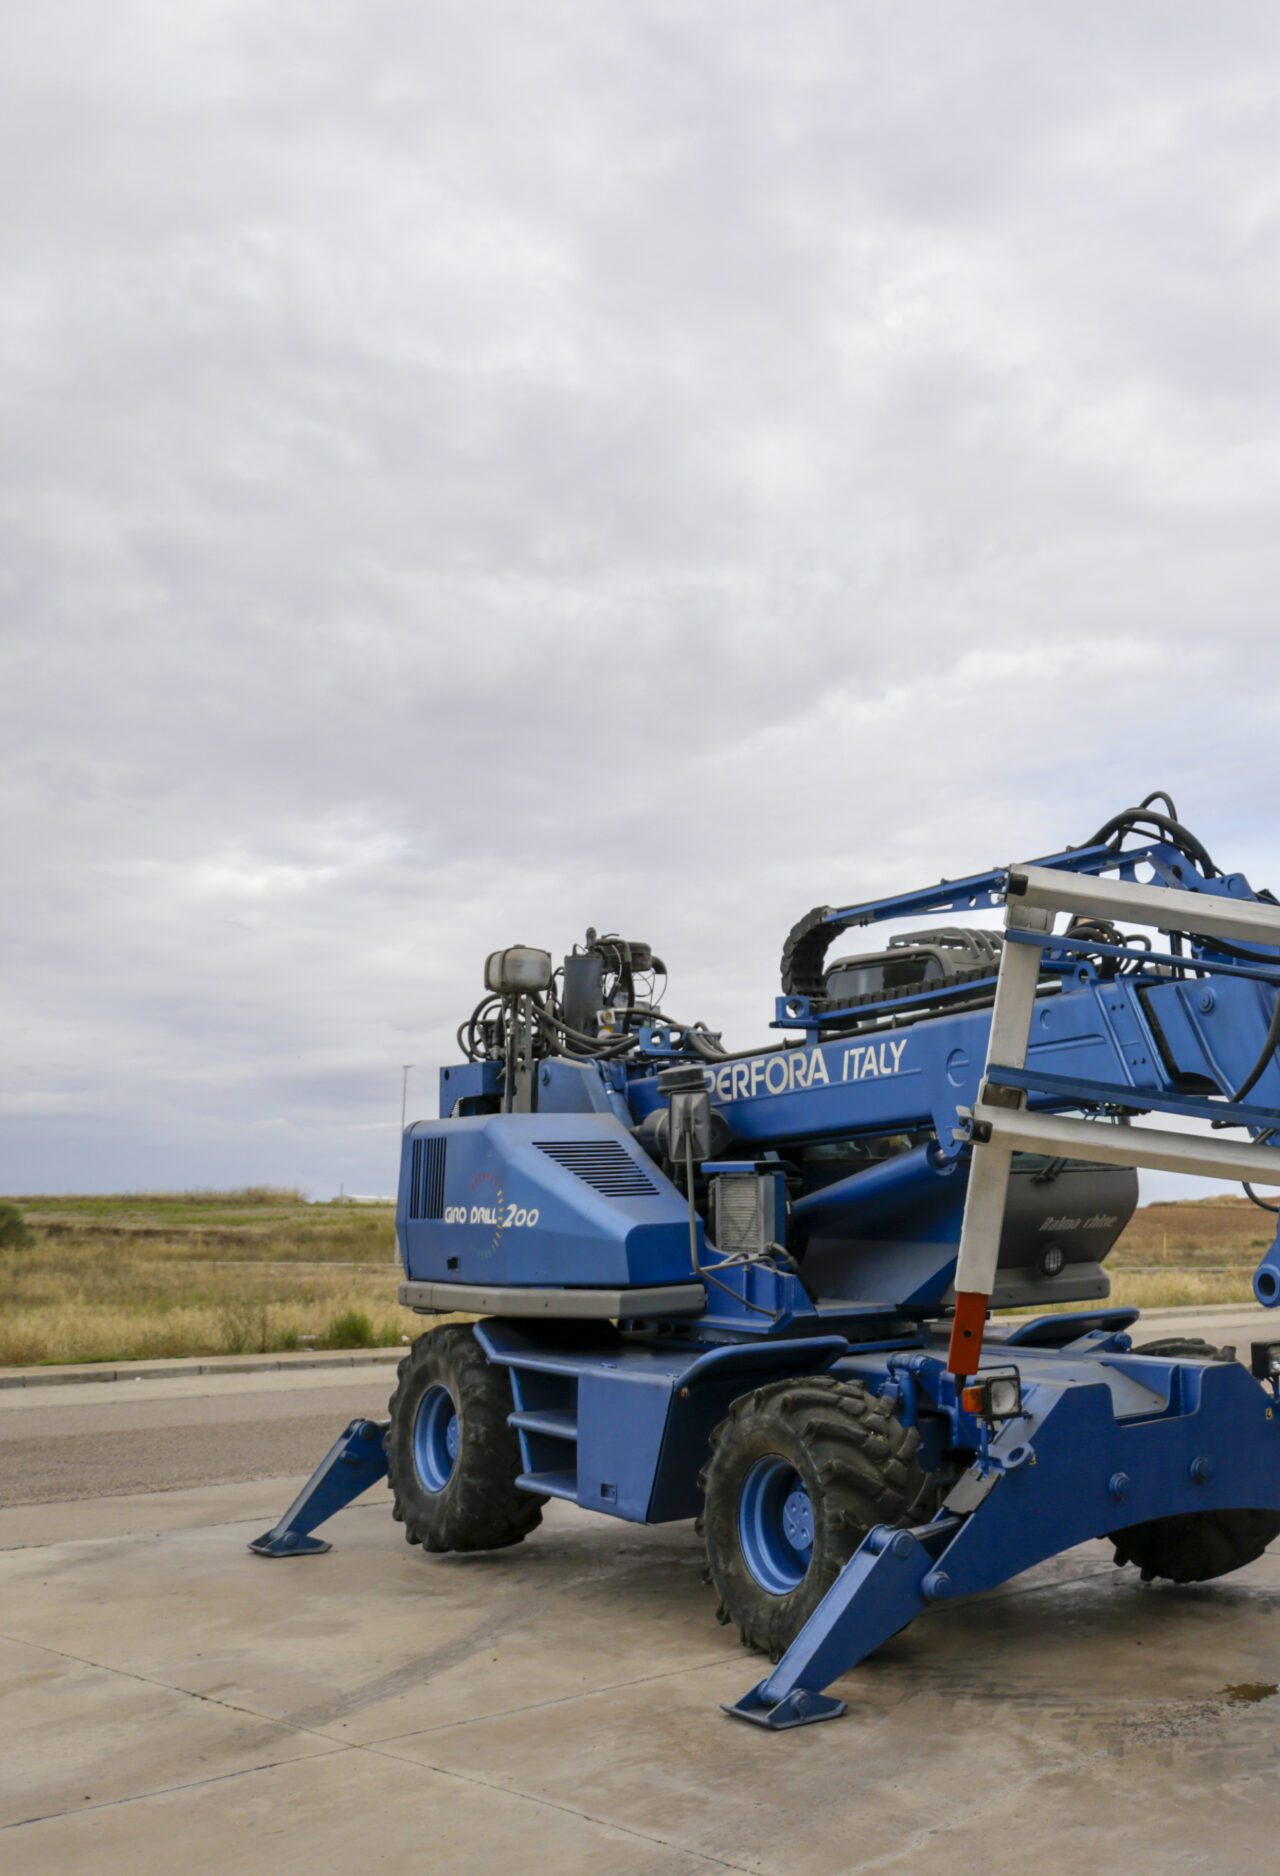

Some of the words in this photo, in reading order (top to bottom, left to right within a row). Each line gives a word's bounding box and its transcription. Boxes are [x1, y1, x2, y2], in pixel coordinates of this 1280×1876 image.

[842, 1039, 908, 1081] ITALY
[444, 1206, 467, 1225] GIRO
[470, 1206, 498, 1225] DRILL
[502, 1203, 540, 1227] 200
